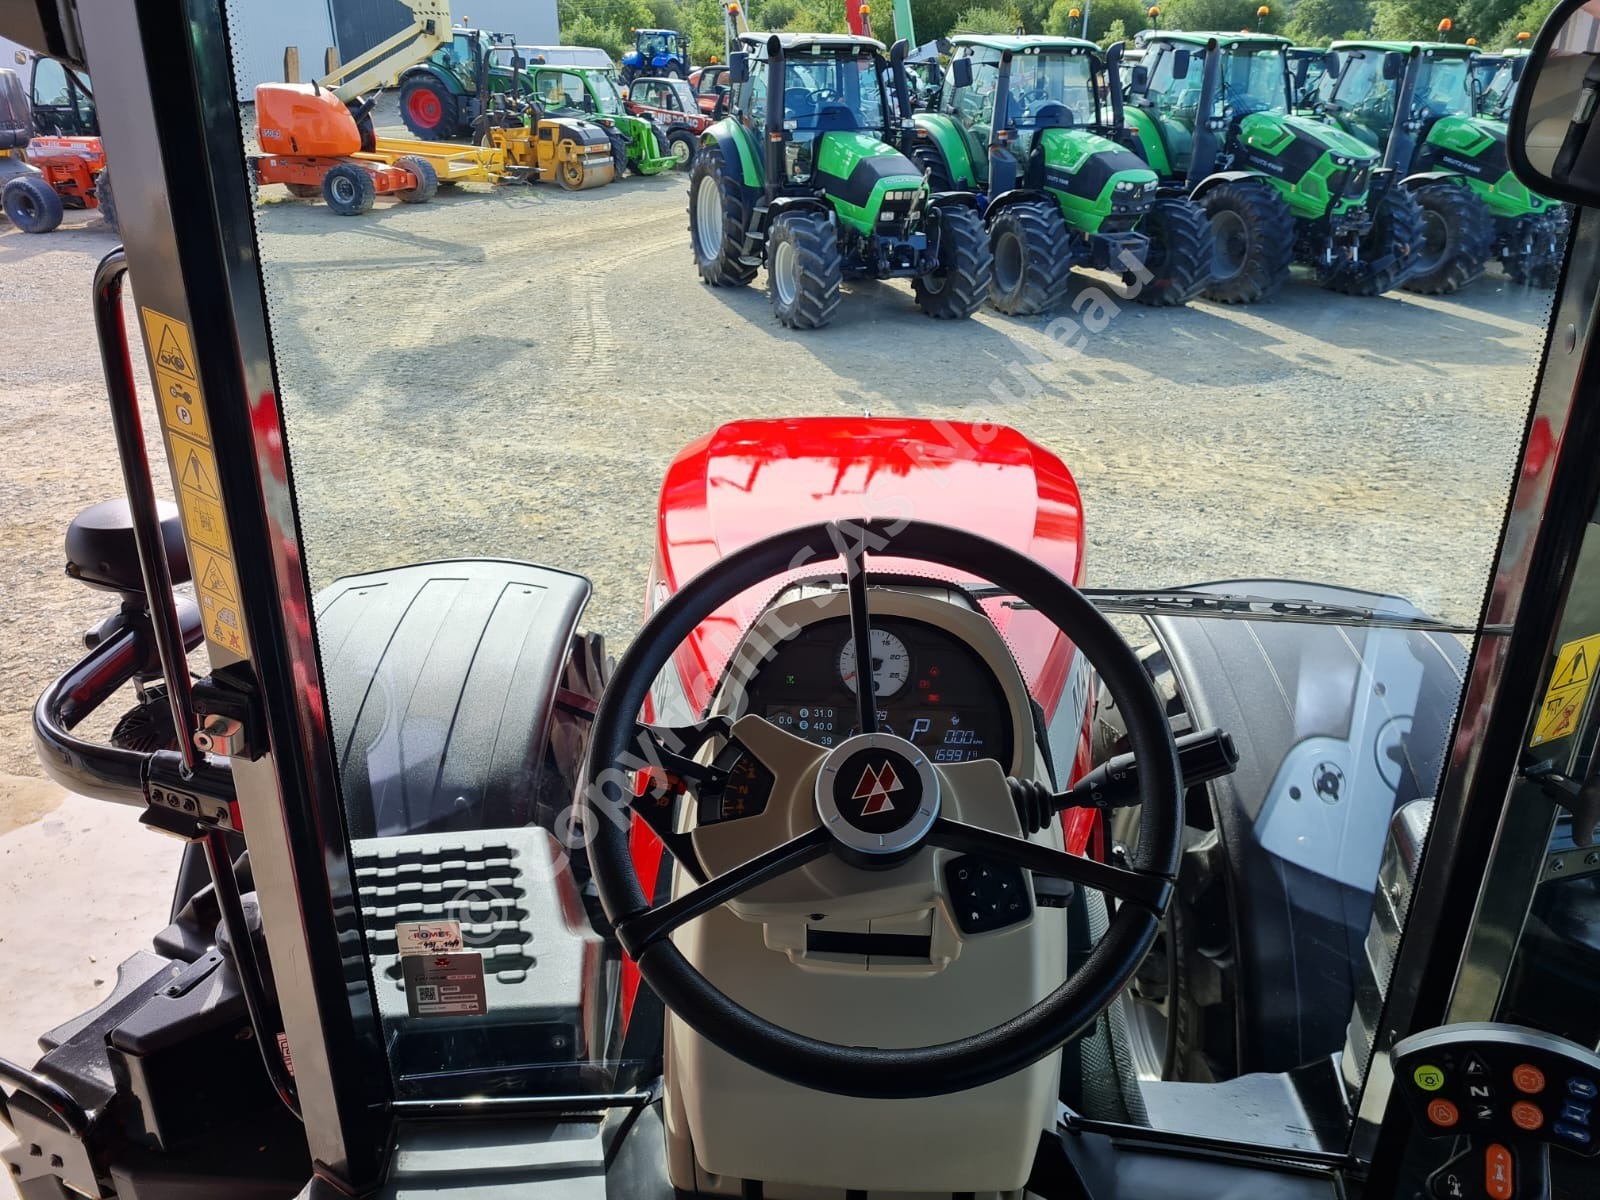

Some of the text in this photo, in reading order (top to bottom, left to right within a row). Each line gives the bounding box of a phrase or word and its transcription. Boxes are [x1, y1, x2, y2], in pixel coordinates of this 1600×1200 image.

[814, 709, 833, 718] 31.0
[778, 716, 793, 725] 0.0
[813, 722, 833, 731] 40.0
[910, 718, 931, 742] P
[821, 736, 833, 745] 39
[1469, 1085, 1490, 1098] N
